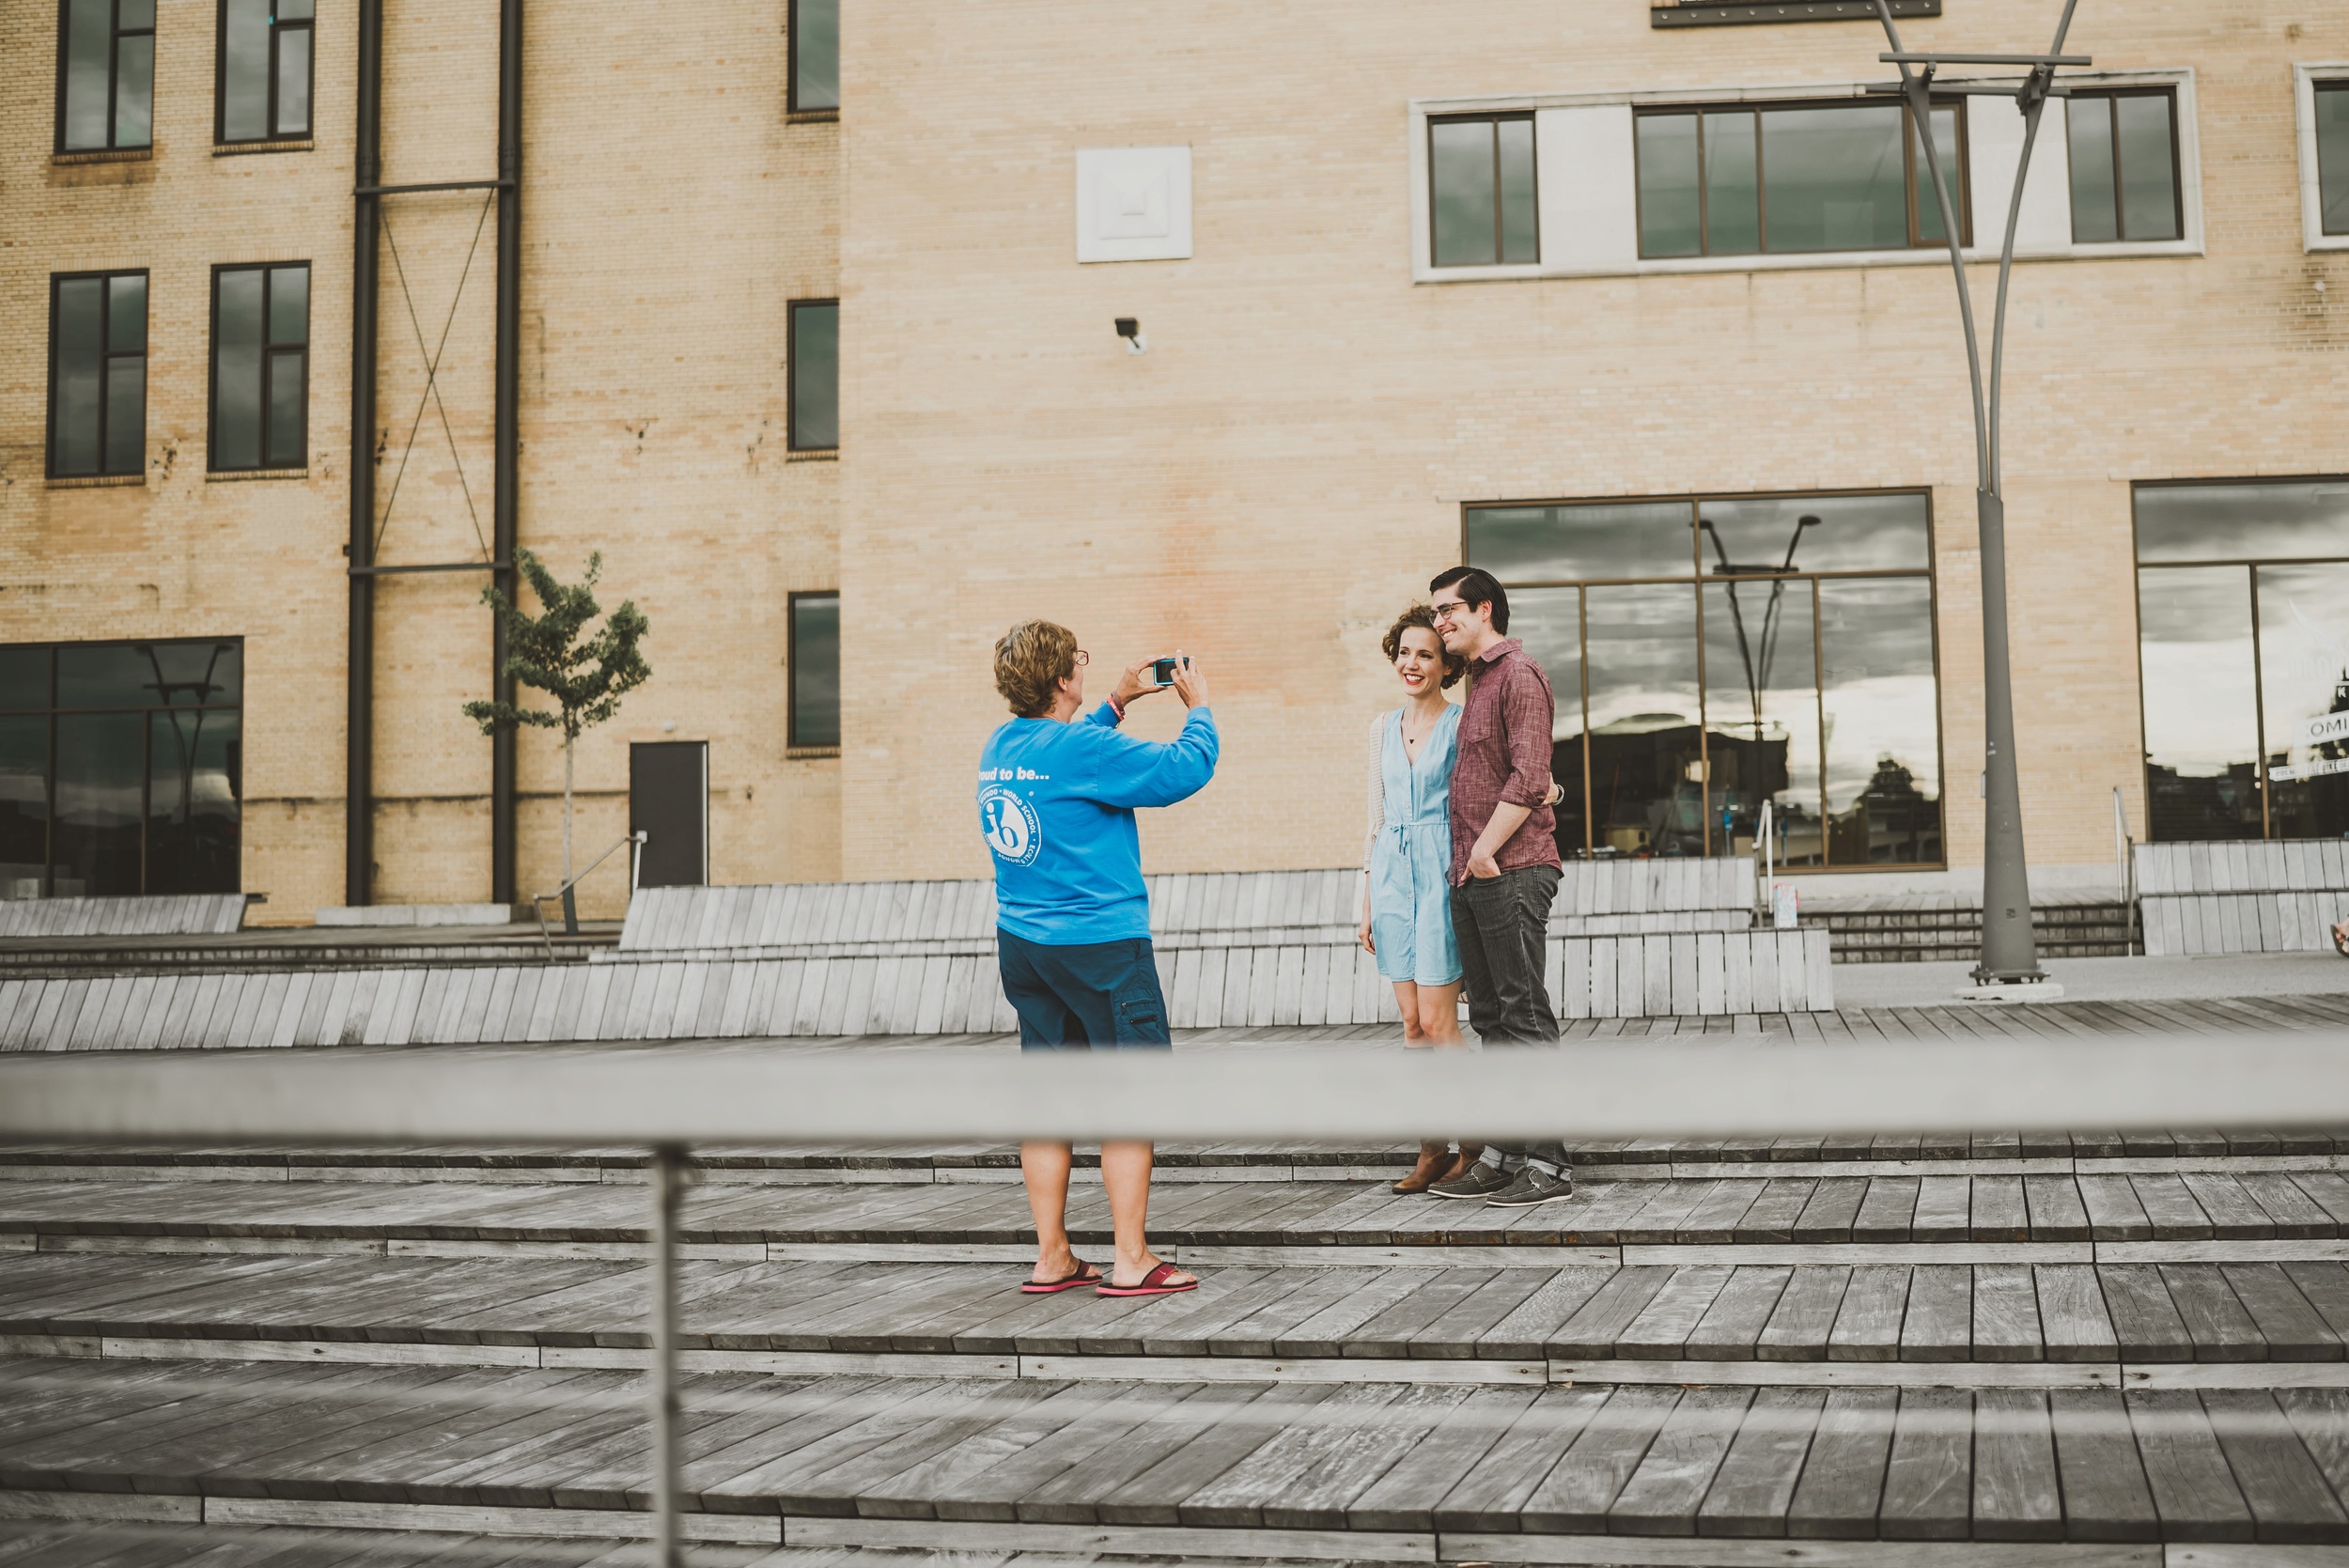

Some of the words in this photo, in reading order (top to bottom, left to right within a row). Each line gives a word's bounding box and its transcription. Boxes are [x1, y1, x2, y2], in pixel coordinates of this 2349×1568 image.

[2305, 716, 2348, 737] OMI
[978, 767, 998, 781] roud
[1000, 768, 1014, 781] to
[1017, 766, 1050, 781] be...
[1003, 788, 1023, 806] WORLD
[1020, 805, 1036, 835] SCHOOL
